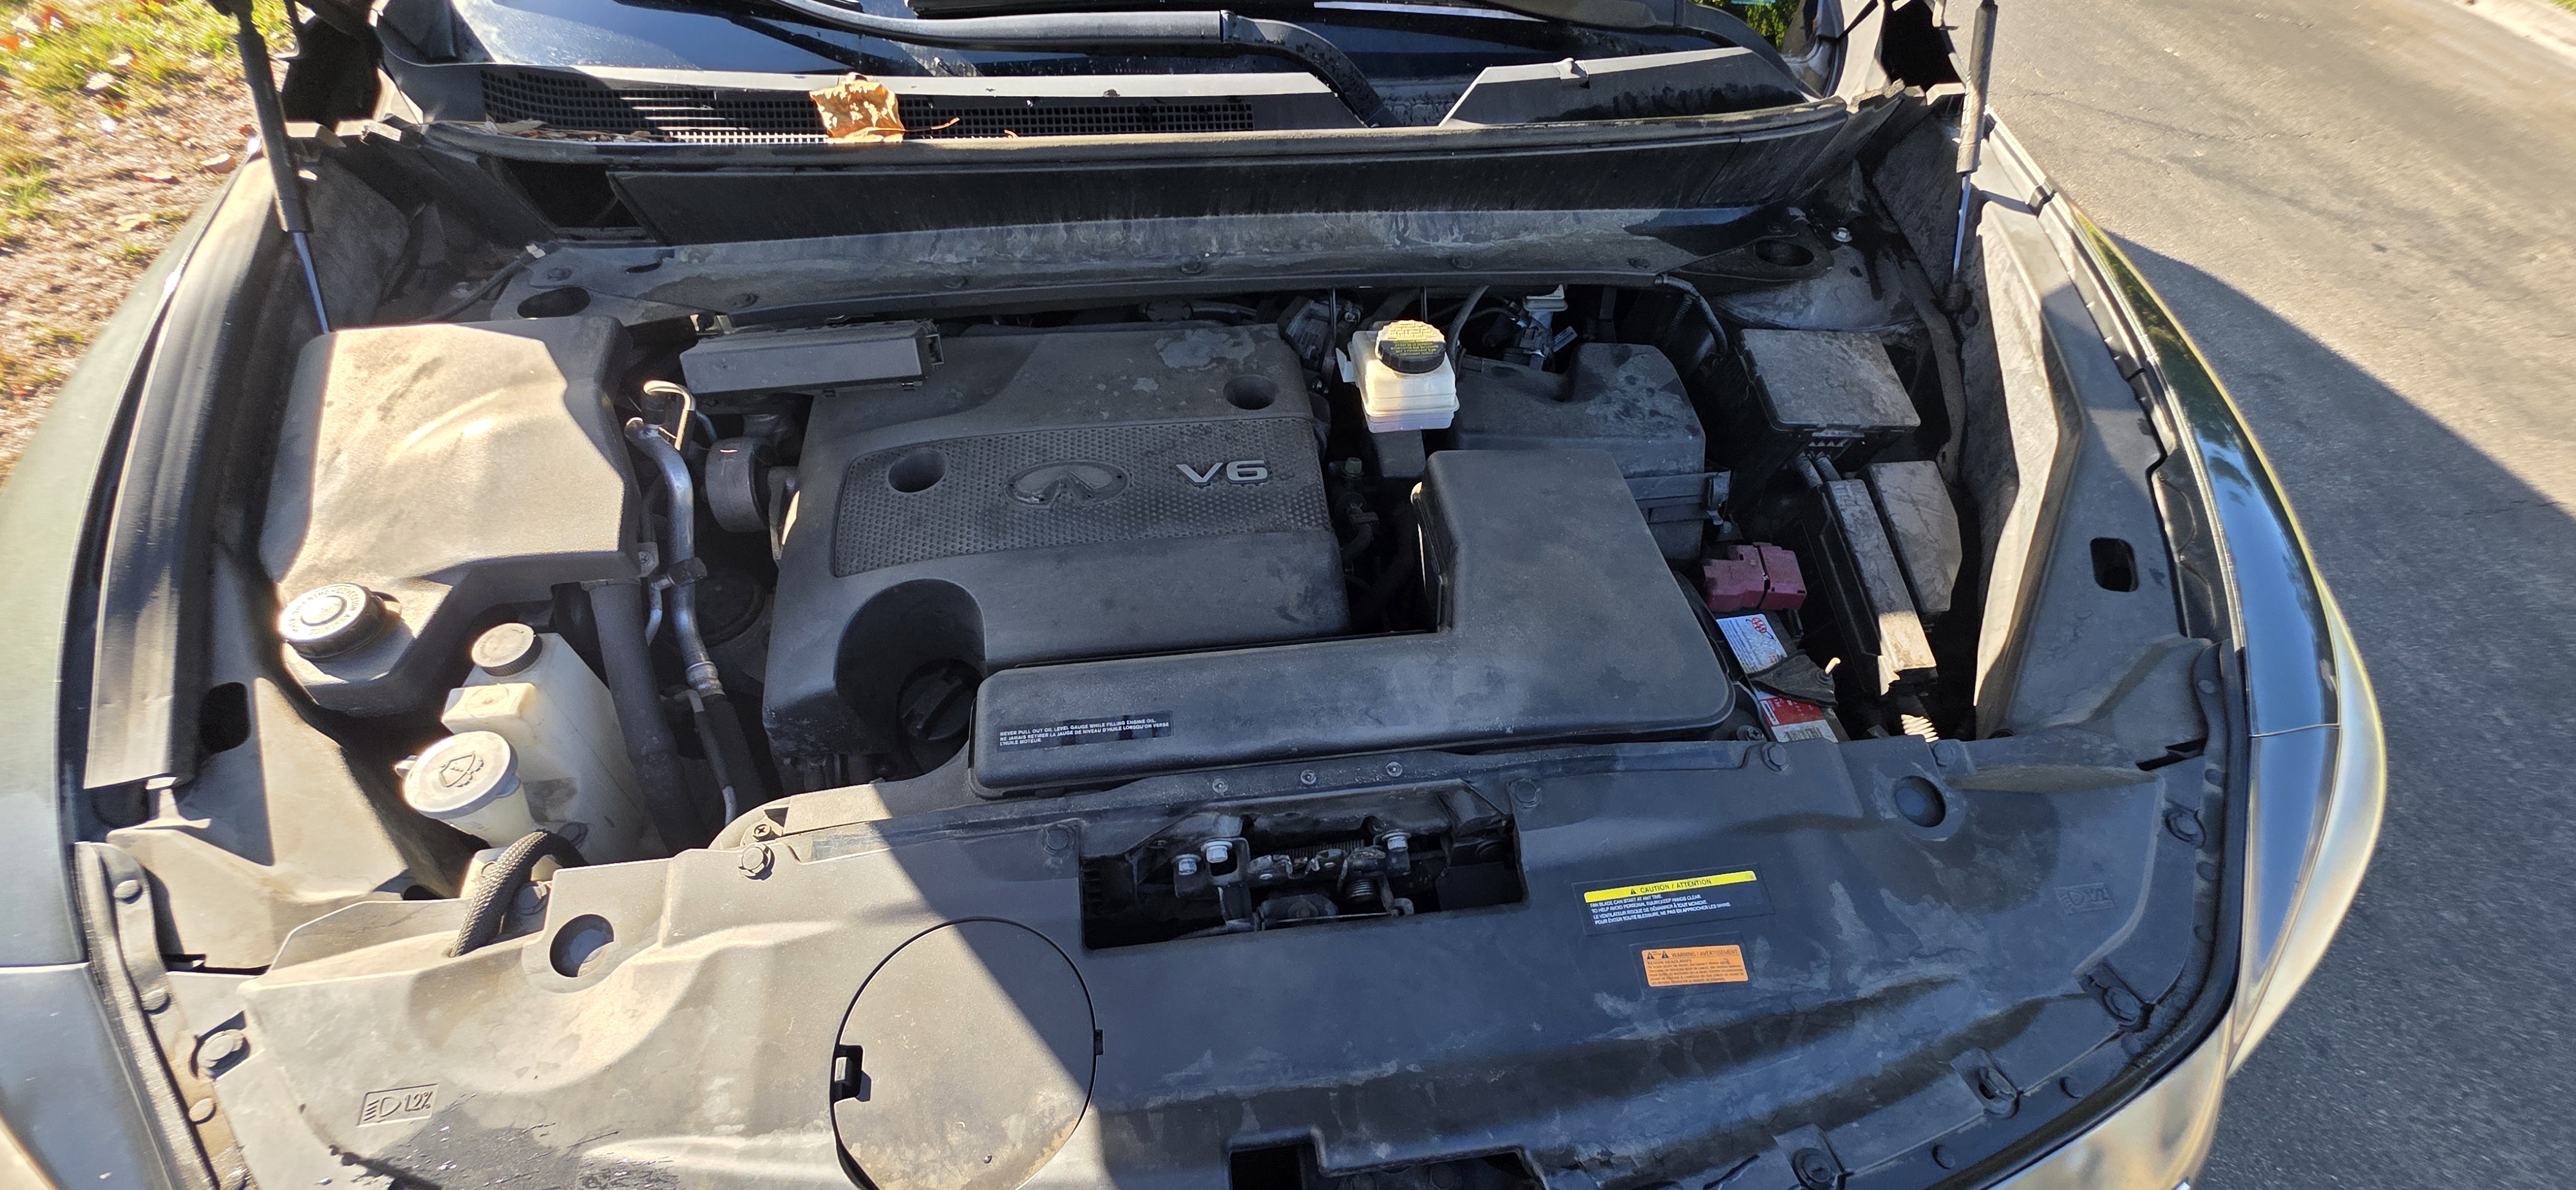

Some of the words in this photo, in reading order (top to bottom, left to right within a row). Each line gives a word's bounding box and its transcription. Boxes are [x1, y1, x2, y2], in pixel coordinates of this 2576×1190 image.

[1176, 460, 1268, 484] V6
[1752, 618, 1766, 634] AAA
[1640, 883, 1670, 893] CAUTION
[1676, 879, 1712, 888] ATTENTION
